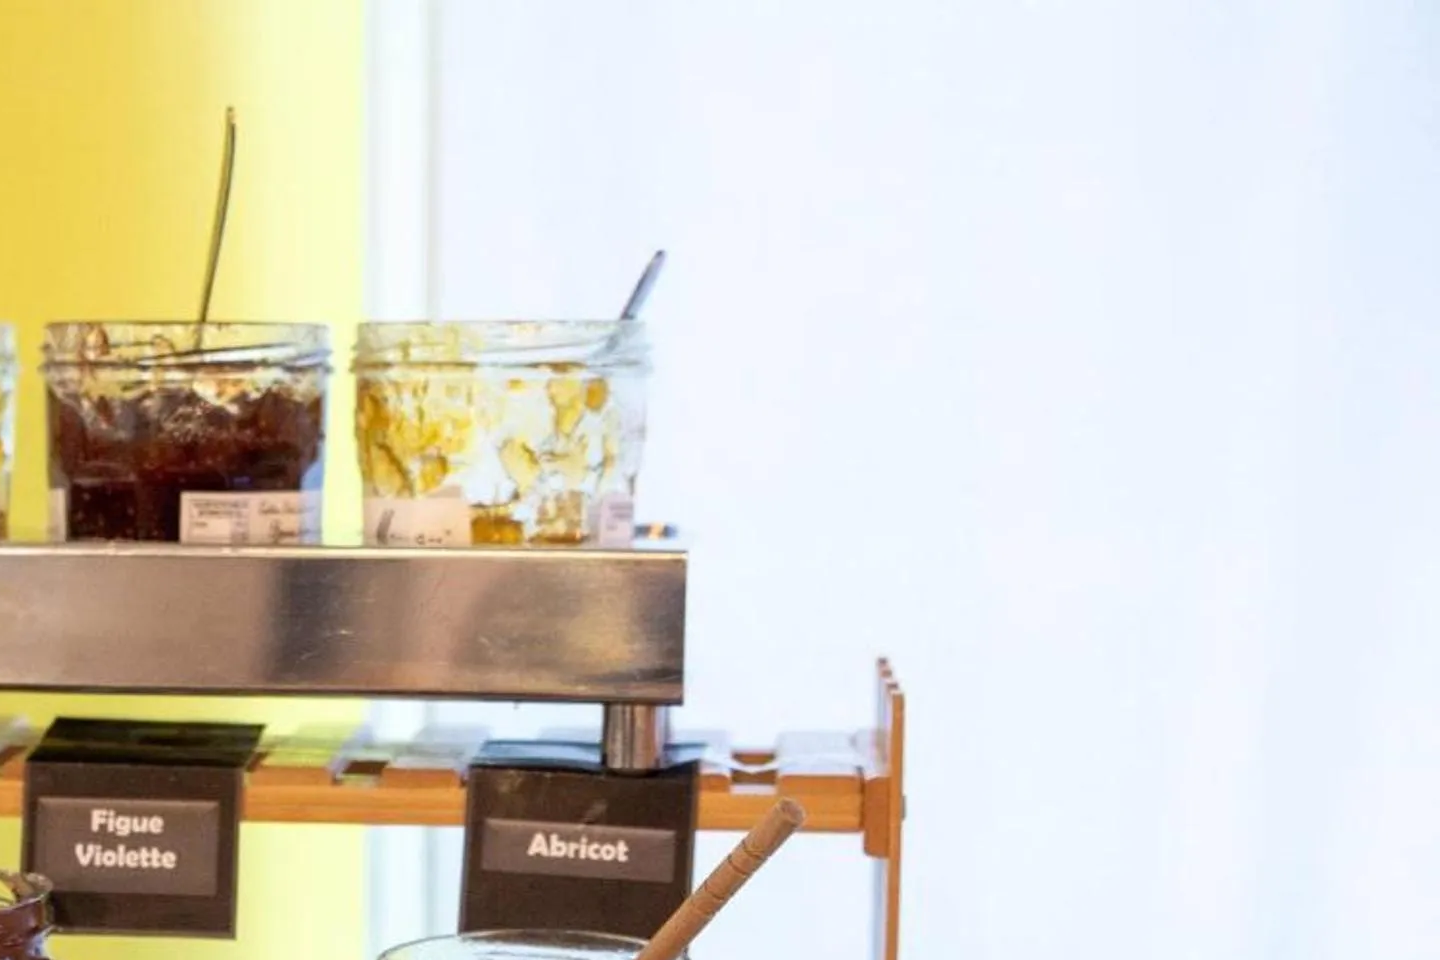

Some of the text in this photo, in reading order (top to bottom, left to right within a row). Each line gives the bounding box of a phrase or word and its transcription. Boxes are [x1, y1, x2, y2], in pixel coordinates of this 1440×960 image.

[89, 808, 165, 836] Figue
[74, 843, 177, 870] Violette
[526, 832, 629, 863] Abricot
